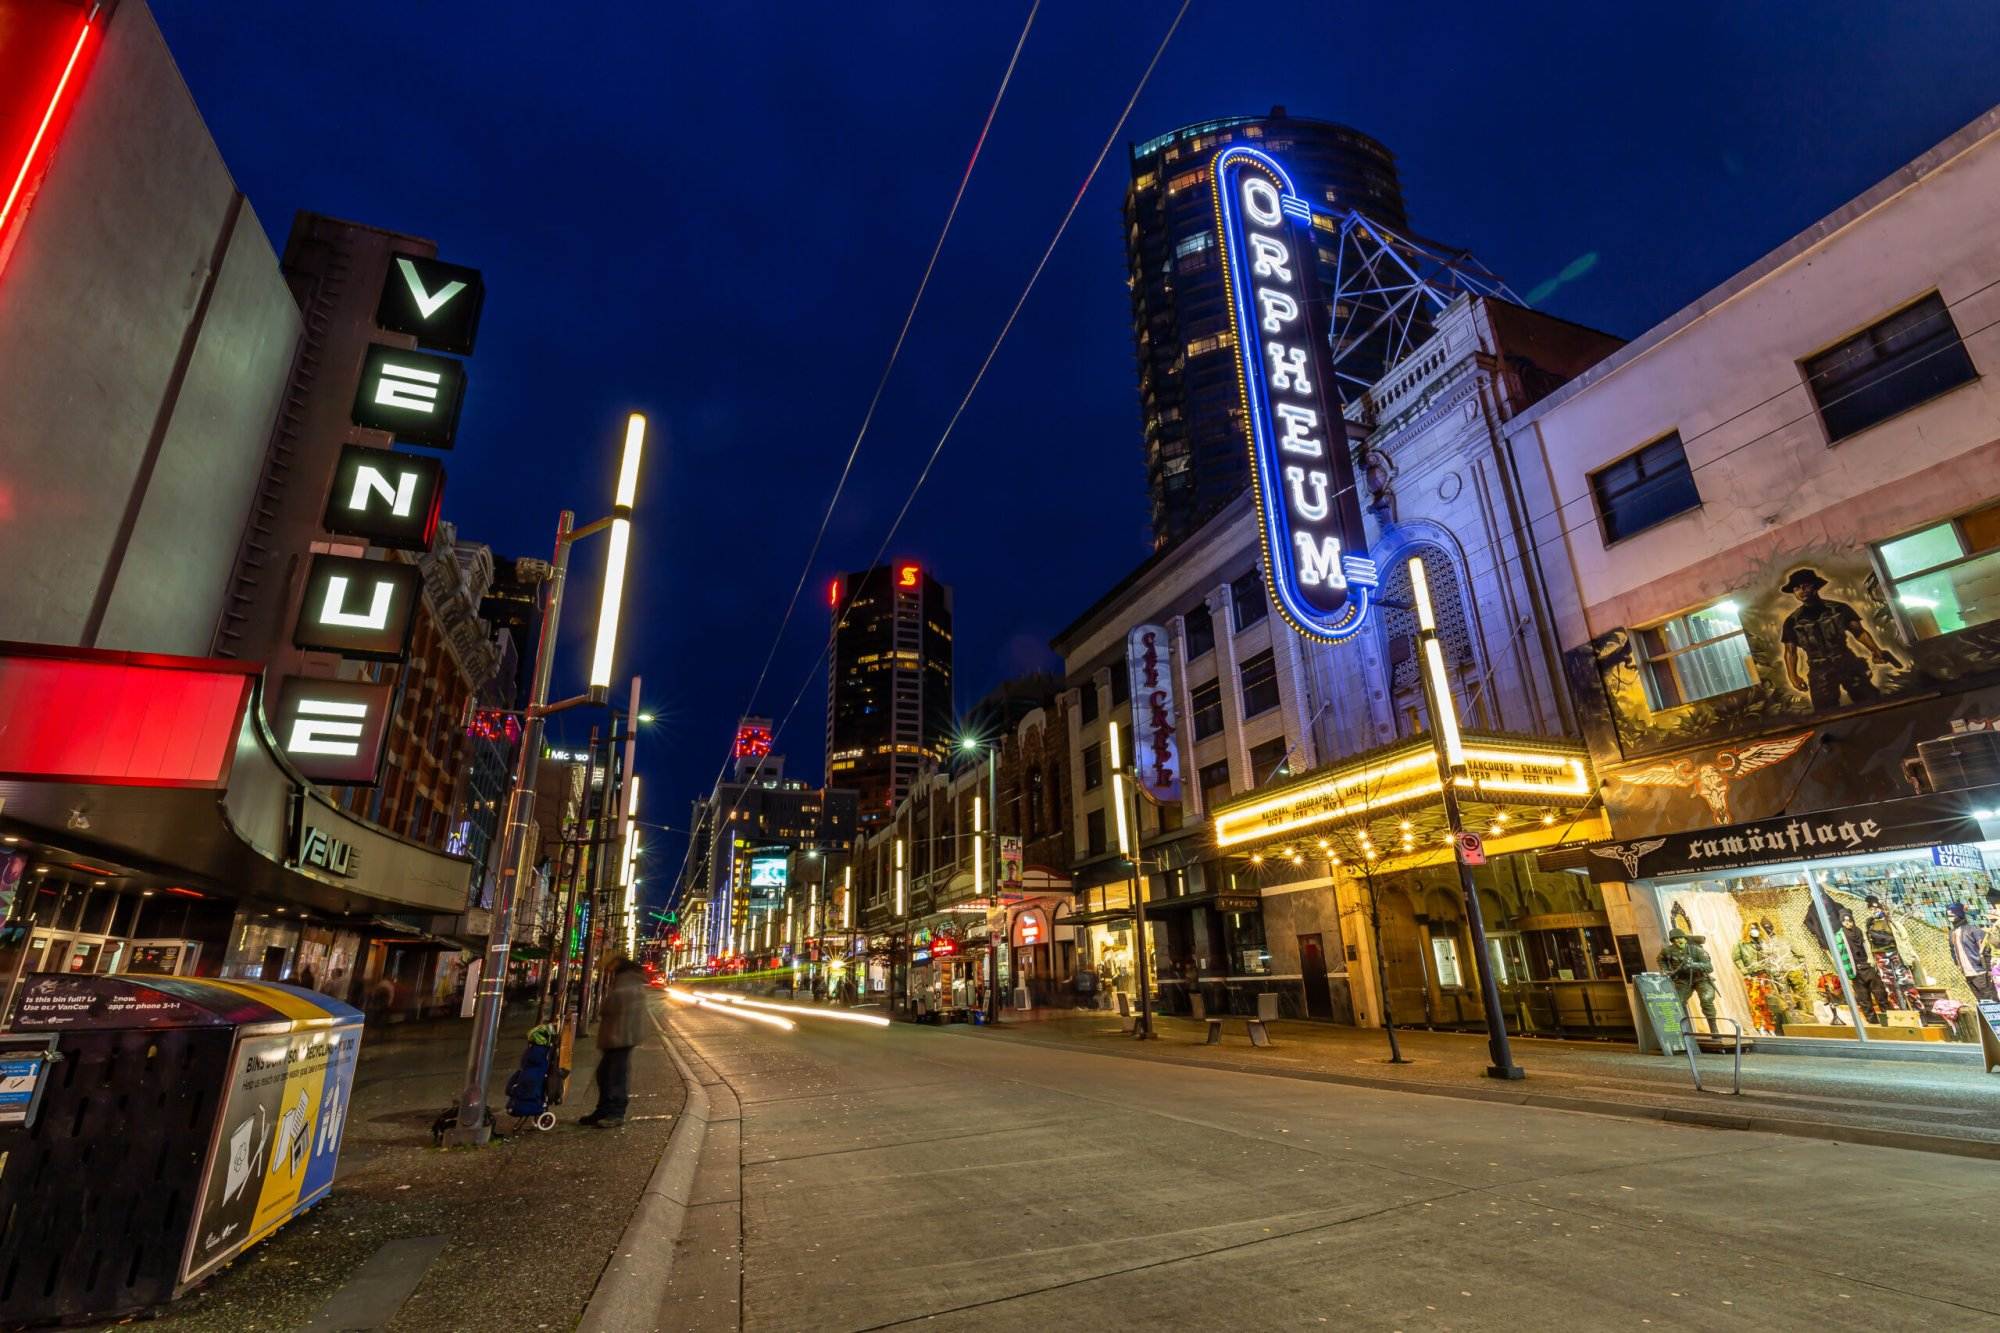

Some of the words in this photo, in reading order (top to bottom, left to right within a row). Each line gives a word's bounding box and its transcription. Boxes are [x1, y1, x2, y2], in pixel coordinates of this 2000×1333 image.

[1242, 176, 1347, 591] ORPHEUM
[288, 257, 466, 757] VENUE
[1467, 760, 1514, 772] VANCOUVER
[1521, 765, 1563, 776] SYMPHONY
[1501, 773, 1510, 782] IT
[1523, 774, 1542, 784] FEEL
[1546, 776, 1554, 784] IT
[1261, 807, 1289, 821] NATIONAL
[1295, 793, 1335, 810] GEOGRAPHIC
[1346, 784, 1362, 797] LIVE
[301, 825, 362, 880] VENUE
[1937, 844, 1980, 858] CURRENCY
[1939, 854, 1983, 871] EXCHANGE
